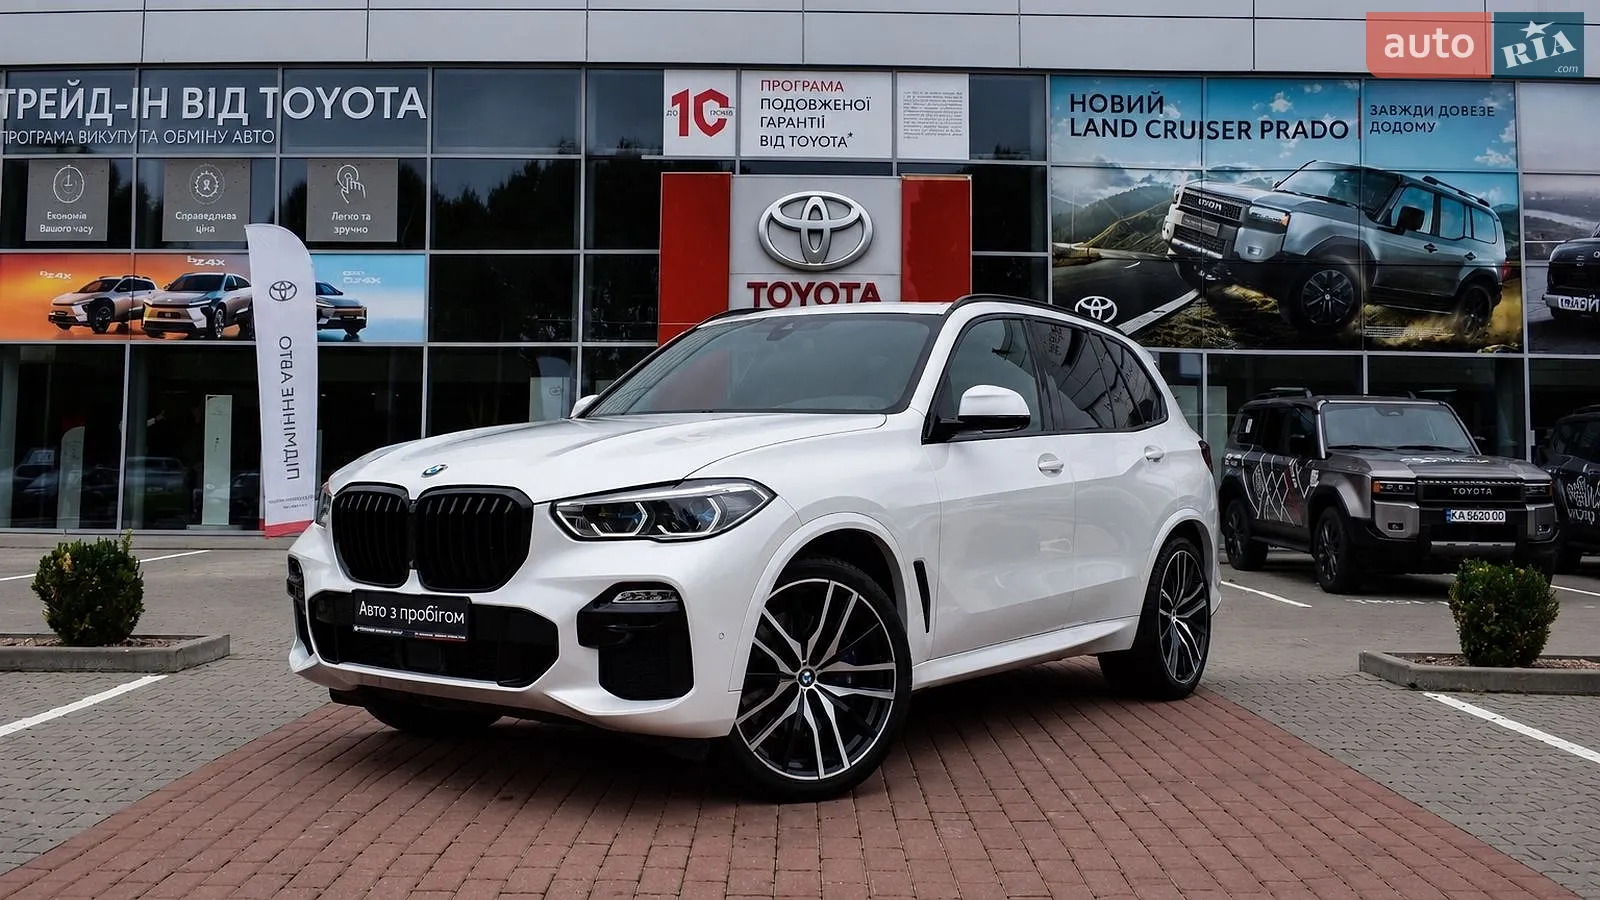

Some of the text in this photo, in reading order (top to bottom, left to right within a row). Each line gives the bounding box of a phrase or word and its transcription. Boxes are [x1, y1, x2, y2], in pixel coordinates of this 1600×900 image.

[760, 80, 845, 92] ПРОГРАМА
[0, 79, 427, 126] ТРЕЙД-ІН ВІД TOYOTA
[760, 96, 872, 112] ПОДОВЖЕНОЇ
[1070, 91, 1164, 114] НОВИЙ
[671, 88, 729, 137] 10
[1370, 104, 1495, 118] ЗАВЖДИ ДОВЕЗЕ
[760, 115, 825, 128] ГАРАНТІЇ
[1370, 121, 1436, 135] ДОДОМУ
[1070, 118, 1349, 140] LAND CRUISER PRADO
[78, 130, 138, 144] ВИКУПУ
[139, 130, 159, 144] ТА
[163, 130, 229, 144] ОБМІНУ
[232, 130, 275, 144] АВТО
[760, 135, 785, 149] ВІД
[175, 211, 237, 221] Справедлива
[195, 224, 216, 234] ціна
[333, 226, 369, 236] зручно
[747, 281, 882, 310] TOYOTA
[1452, 487, 1493, 495] TOYOTA
[1451, 511, 1465, 521] KA
[359, 600, 465, 624] Авто з пробігом
